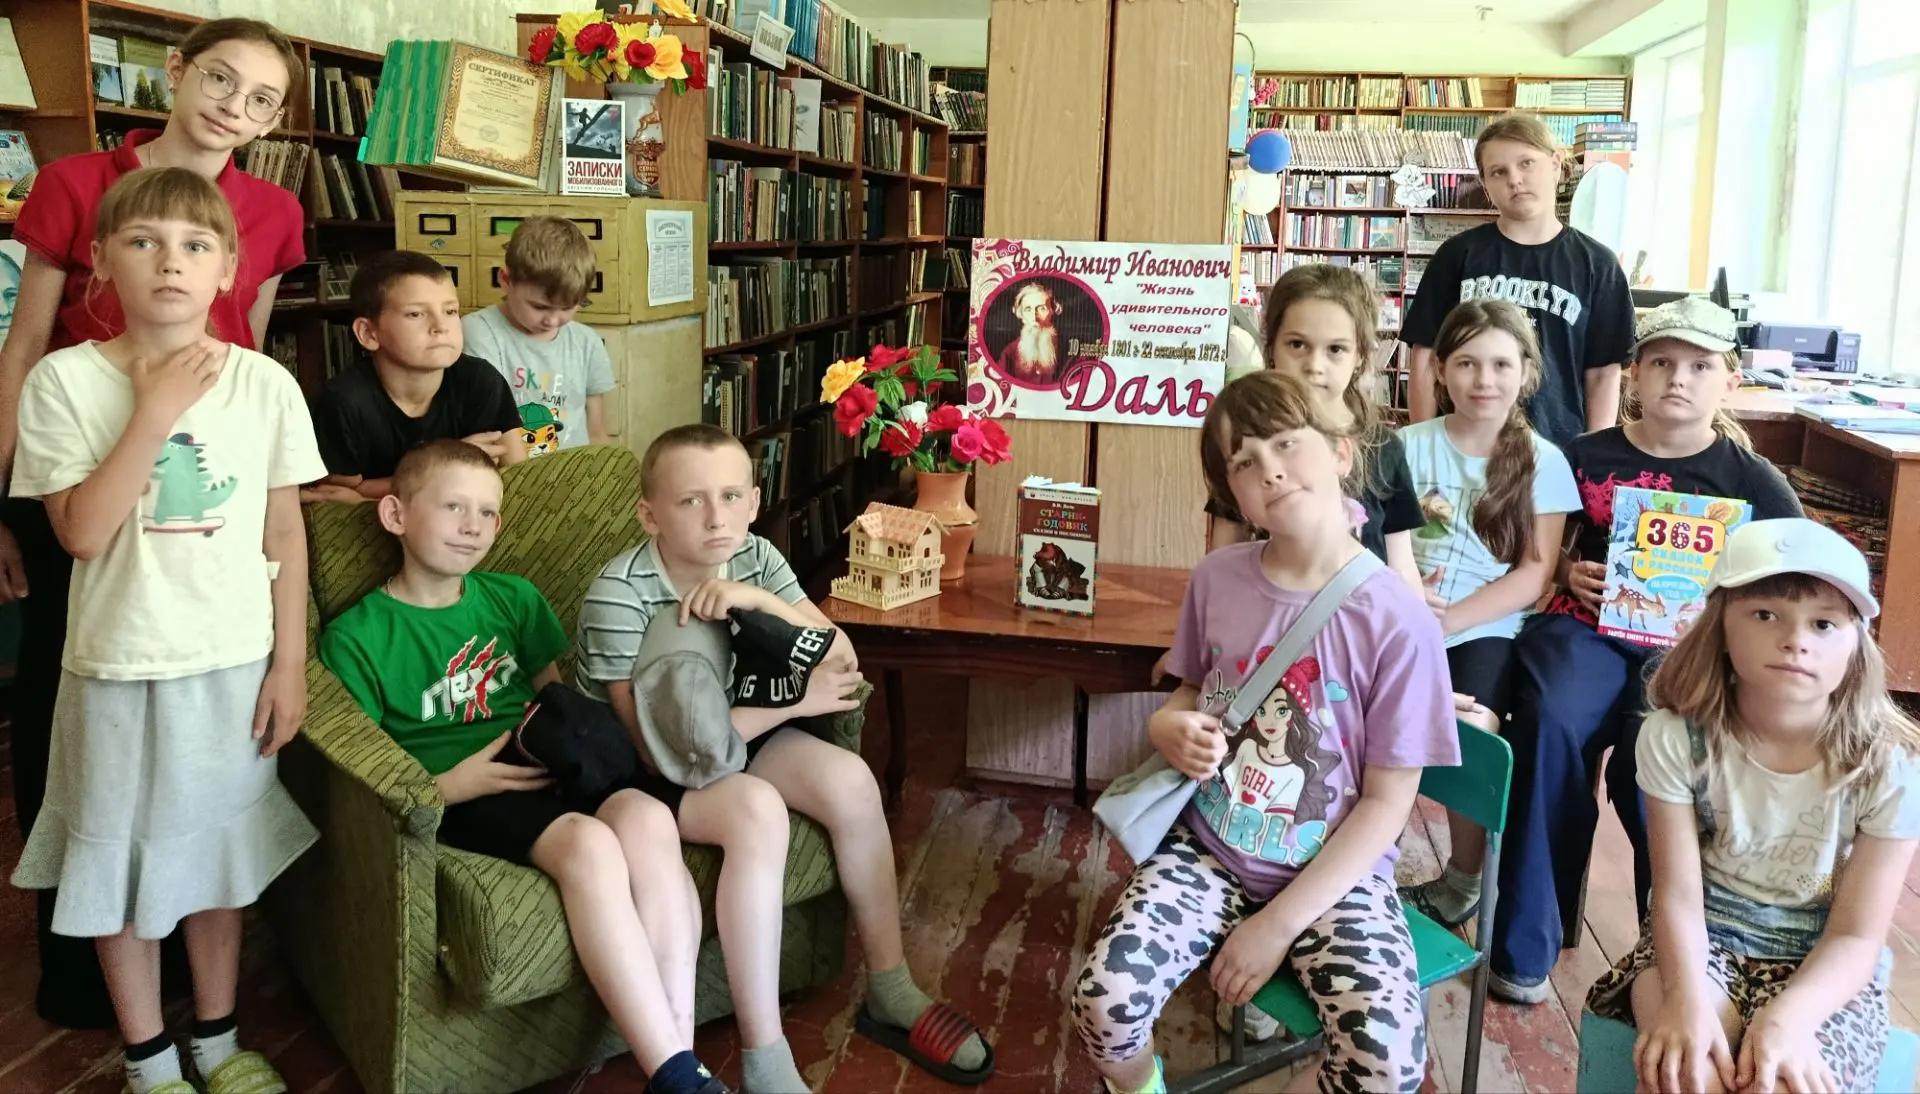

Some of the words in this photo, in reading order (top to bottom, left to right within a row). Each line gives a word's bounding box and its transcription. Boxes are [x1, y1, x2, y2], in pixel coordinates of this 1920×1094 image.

[468, 62, 537, 87] СЕРТИФИКАТ
[567, 160, 622, 178] ЗАПИСКИ
[567, 177, 623, 187] МОБИЛИЗОВАННОГО
[1012, 245, 1121, 284] Владимир
[1124, 249, 1231, 279] Иванович
[1136, 283, 1195, 297] "Жизнь
[1460, 274, 1582, 326] BROOKLYN
[1109, 302, 1228, 316] удивительного
[1129, 324, 1212, 336] человека"
[1111, 339, 1132, 357] 1801
[1141, 340, 1153, 359] 22
[1198, 343, 1220, 362] 1872
[514, 367, 563, 395] SKTE
[1060, 360, 1216, 418] Даль
[1037, 517, 1088, 532] ГОДОВИК
[1040, 509, 1086, 521] СТАРИК-
[1647, 517, 1714, 554] 365
[1241, 766, 1276, 800] GIRL
